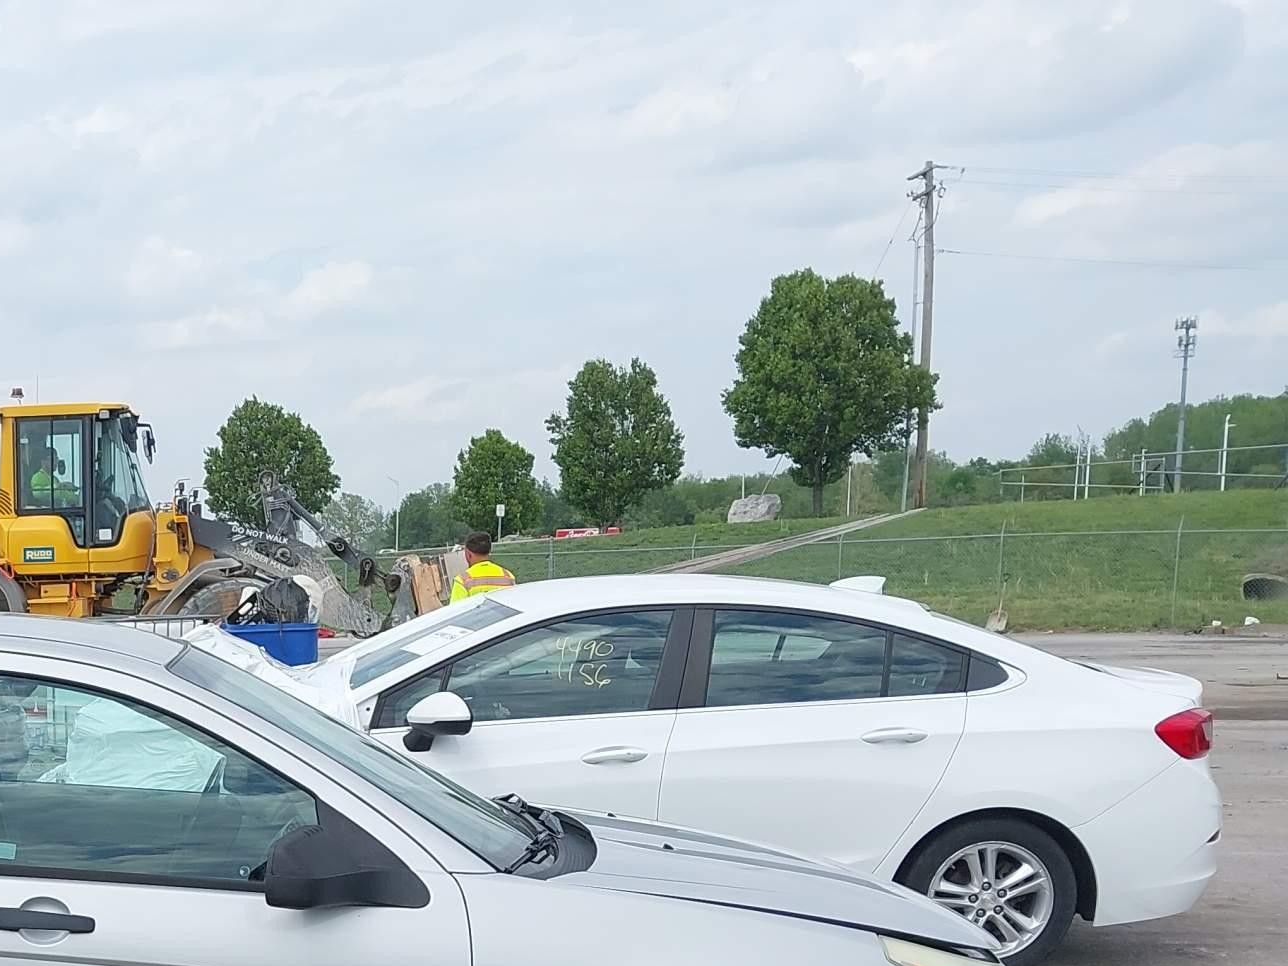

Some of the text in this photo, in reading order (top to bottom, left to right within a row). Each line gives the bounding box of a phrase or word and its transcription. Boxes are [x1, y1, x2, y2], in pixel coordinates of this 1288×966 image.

[232, 525, 289, 545] DO NOT WALK
[243, 547, 269, 565] UNDER
[556, 636, 614, 661] 4490
[558, 662, 612, 689] 1156
